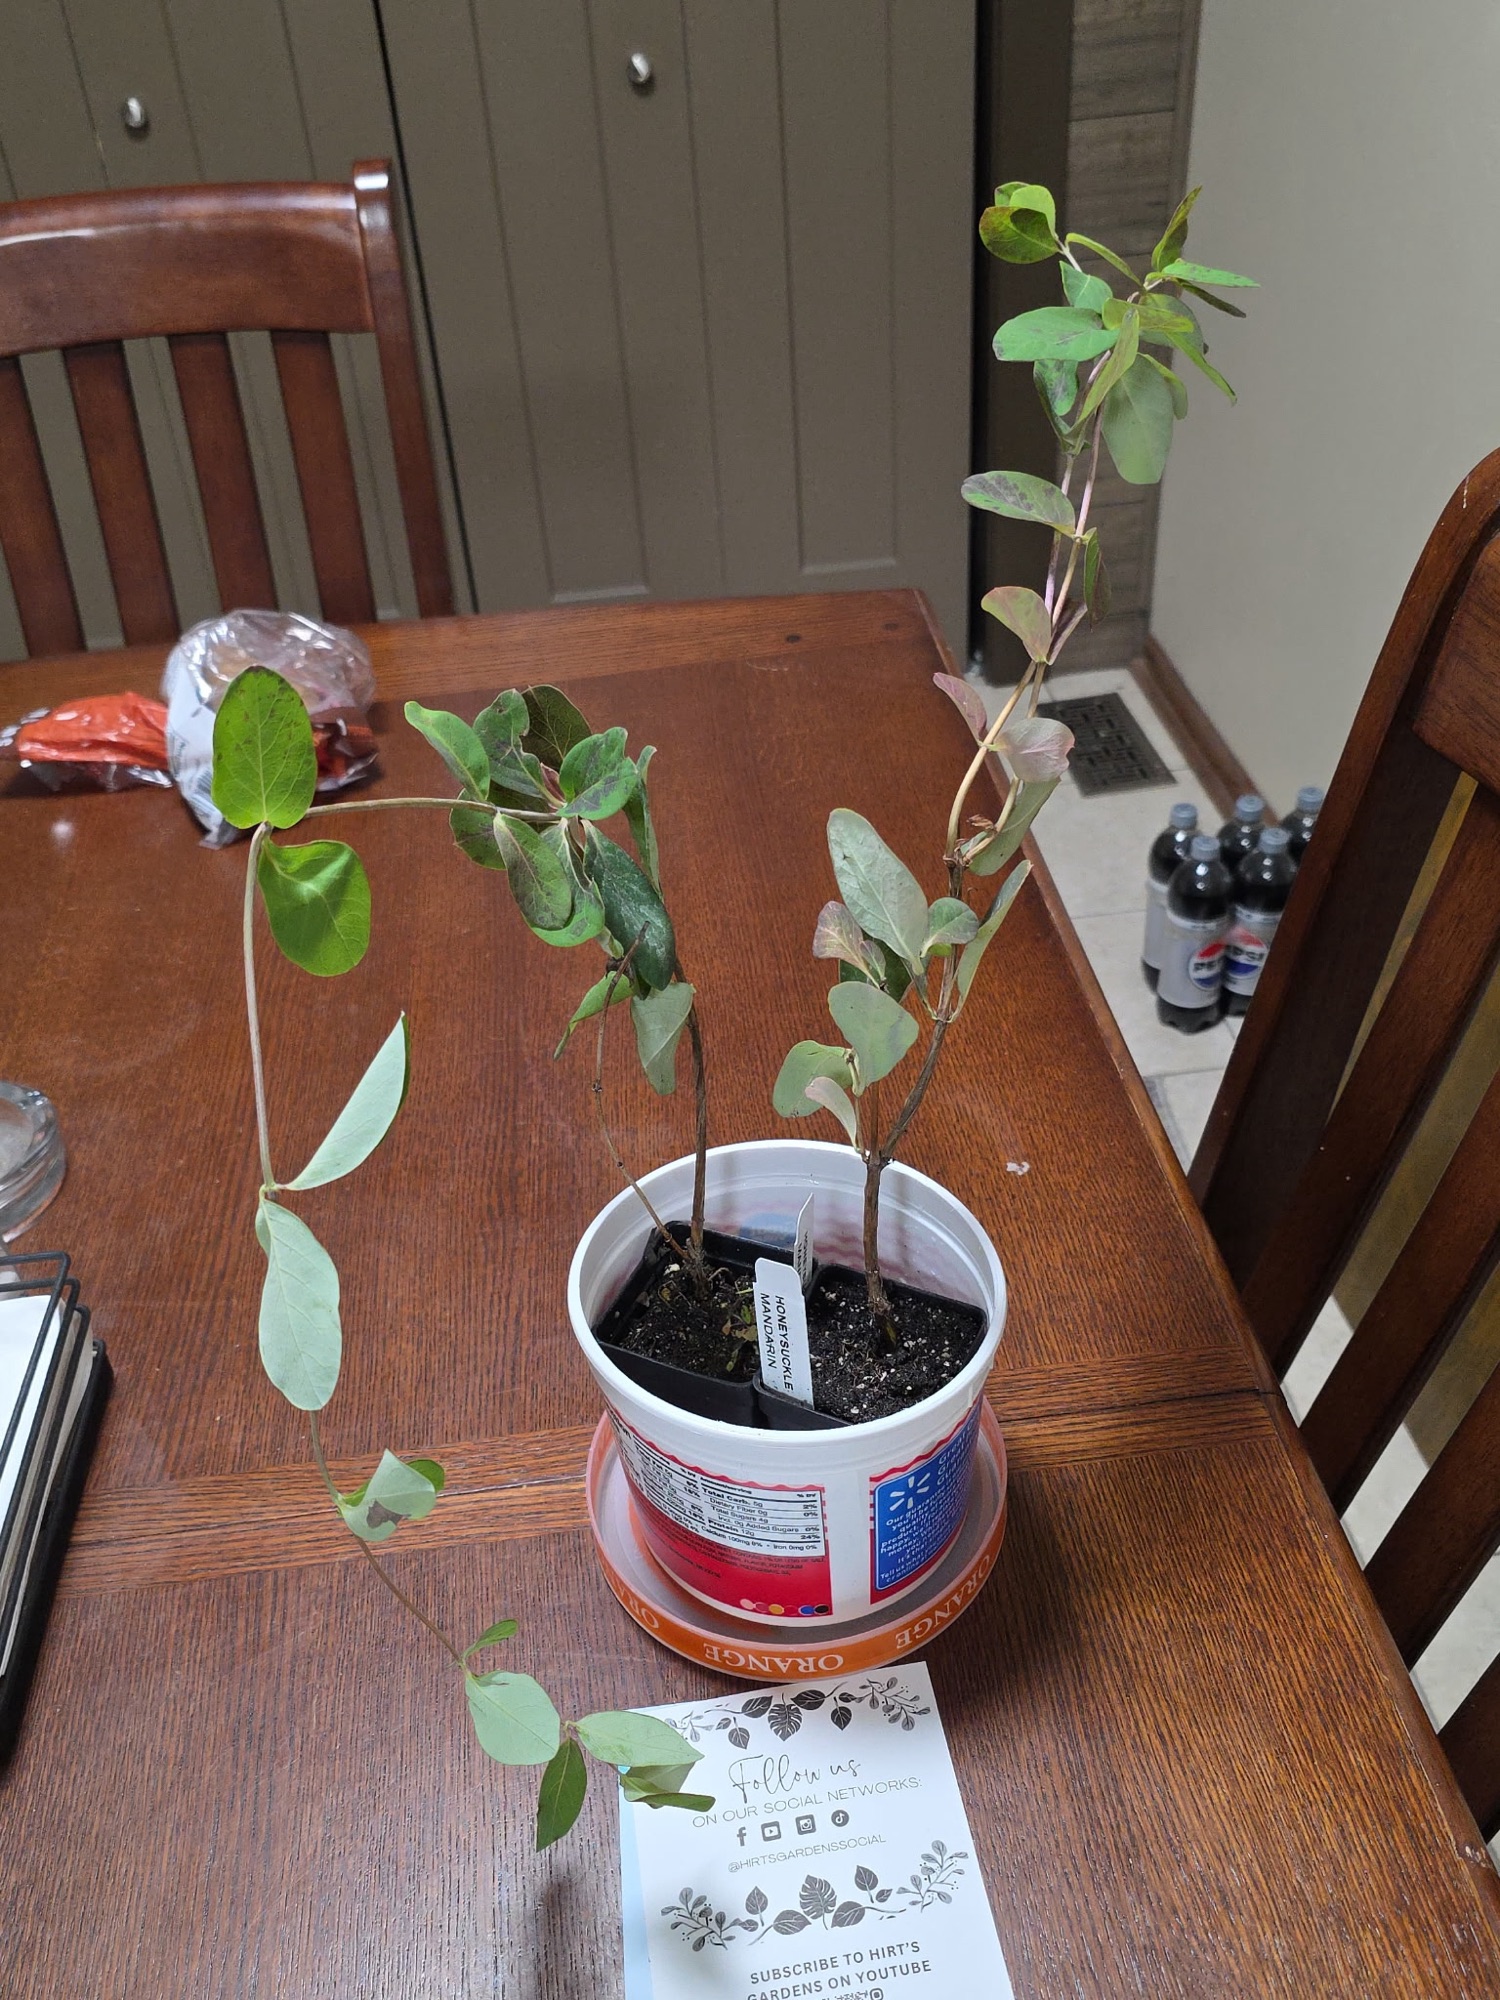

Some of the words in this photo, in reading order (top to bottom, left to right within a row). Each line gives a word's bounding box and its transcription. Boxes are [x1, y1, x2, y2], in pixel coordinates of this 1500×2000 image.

[760, 1292, 777, 1368] MANDARIN
[775, 1295, 794, 1391] HONEYSUCKLE
[702, 1487, 724, 1499] Total
[727, 1495, 750, 1505] Carb.
[710, 1498, 734, 1509] Dietary
[708, 1519, 739, 1532] Protein
[711, 1505, 729, 1515] Total
[730, 1512, 756, 1521] Sugars
[886, 1514, 904, 1526] Our
[702, 1526, 726, 1538] Calcium
[728, 1536, 750, 1545] 100mg
[880, 1568, 895, 1579] Tell
[896, 1554, 990, 1649] ORANGE
[703, 1642, 844, 1672] ORANGE
[728, 1754, 820, 1804] Follow
[830, 1759, 861, 1777] us
[692, 1814, 717, 1828] ON
[722, 1806, 758, 1822] OUR
[764, 1794, 823, 1814] SOCIAL
[827, 1776, 923, 1802] NETWORKS:
[728, 1834, 887, 1873] @HIRTSGARDENSSOCIAL
[750, 1956, 838, 1985] SUBSCRIBE
[843, 1951, 864, 1966] TO
[868, 1940, 920, 1962] HIRT'S
[828, 1974, 851, 1990] ON
[855, 1960, 932, 1985] YOUTUBE
